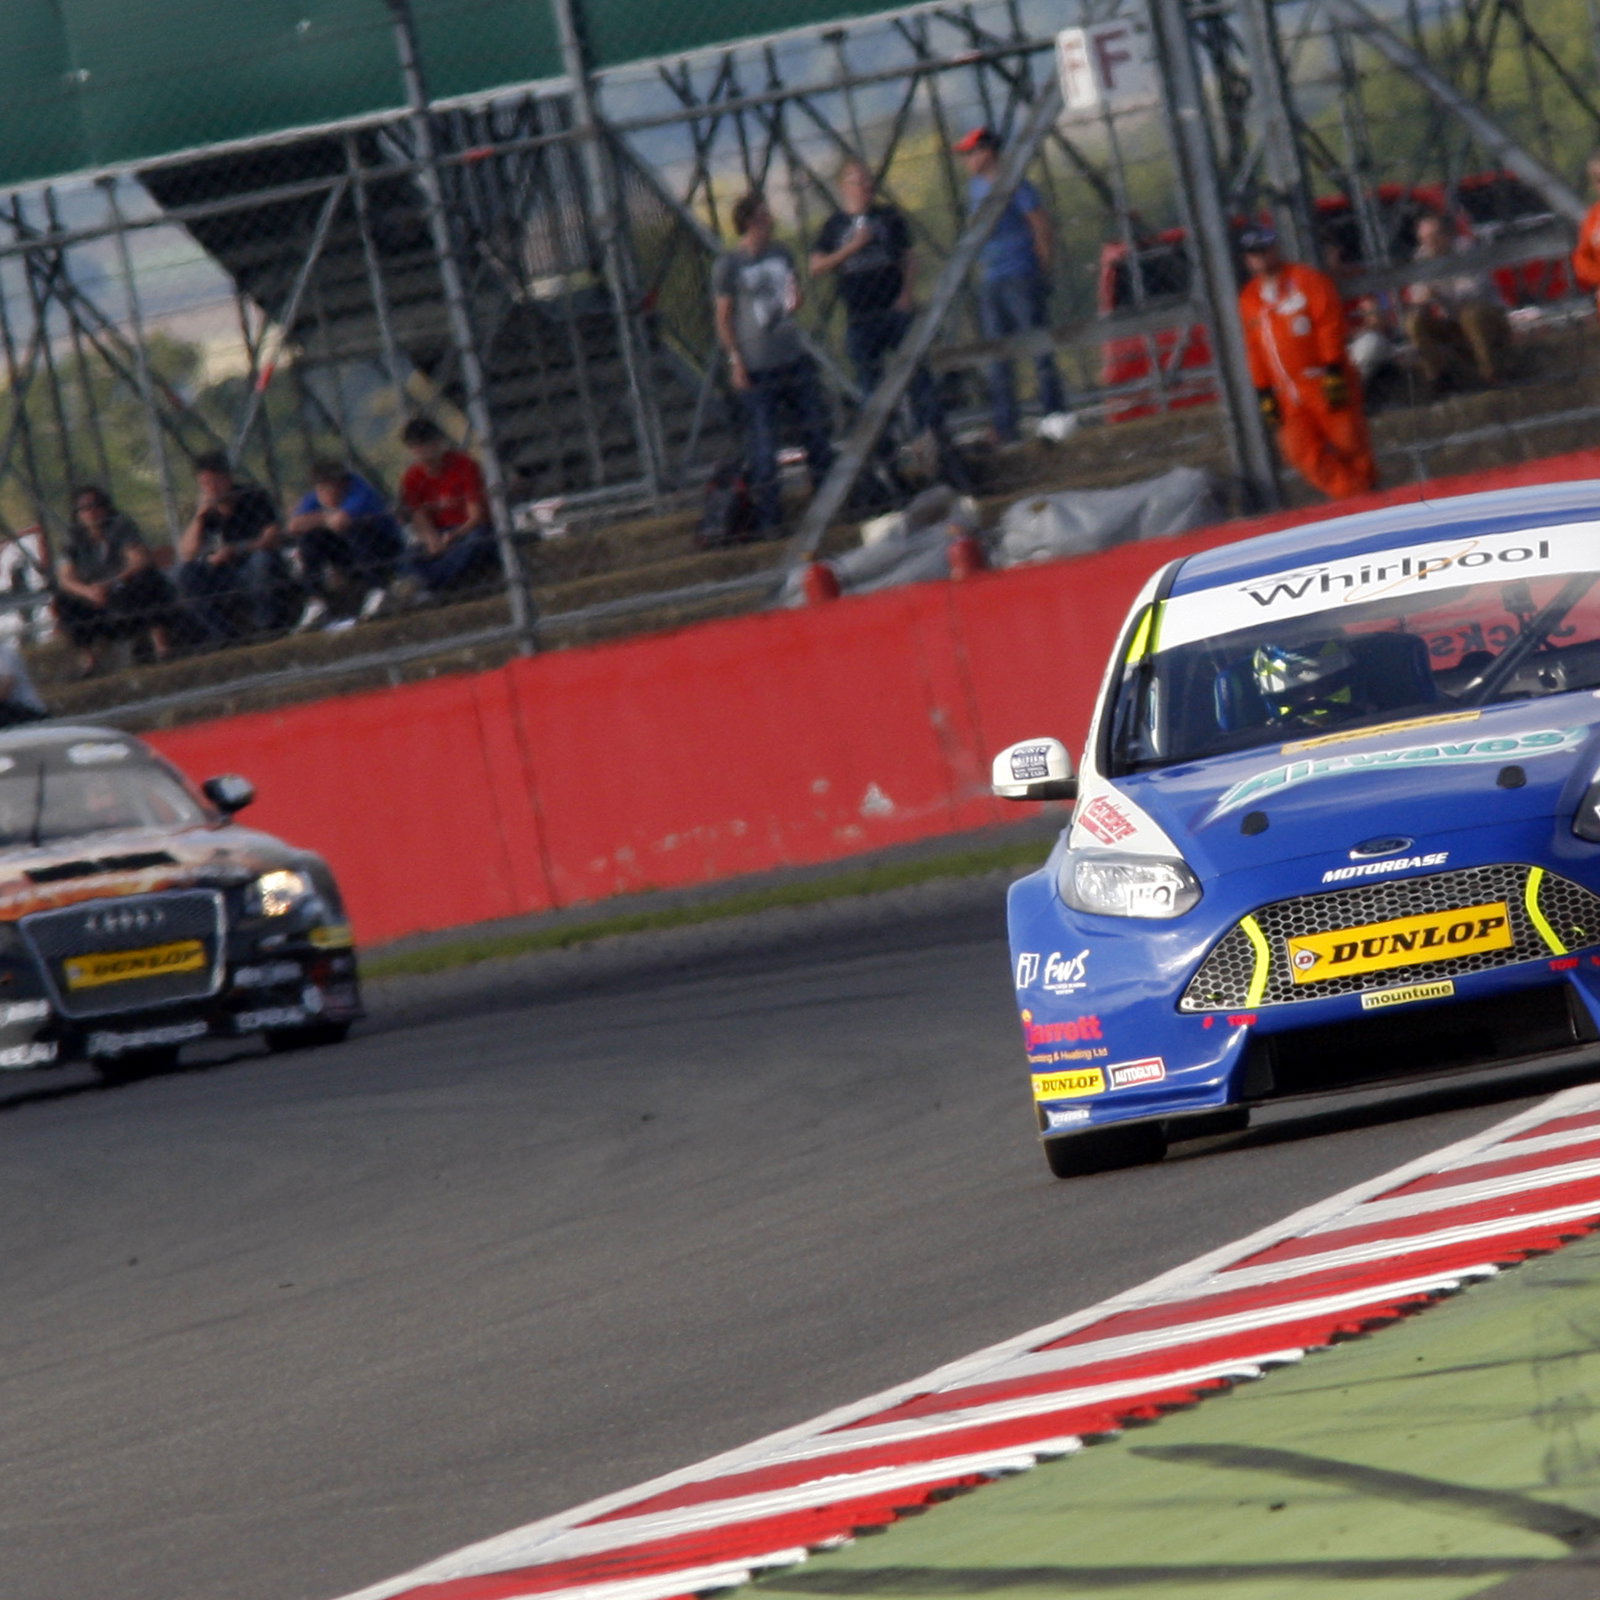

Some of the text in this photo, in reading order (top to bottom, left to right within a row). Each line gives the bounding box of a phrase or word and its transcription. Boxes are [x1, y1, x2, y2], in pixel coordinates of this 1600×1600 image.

[1094, 30, 1130, 88] F
[1248, 540, 1549, 607] Whirlpool
[1321, 851, 1449, 884] MOTORBASE
[1328, 915, 1505, 965] DUNLOP
[1364, 983, 1452, 1006] mountune
[1041, 1075, 1099, 1092] DUNLOP
